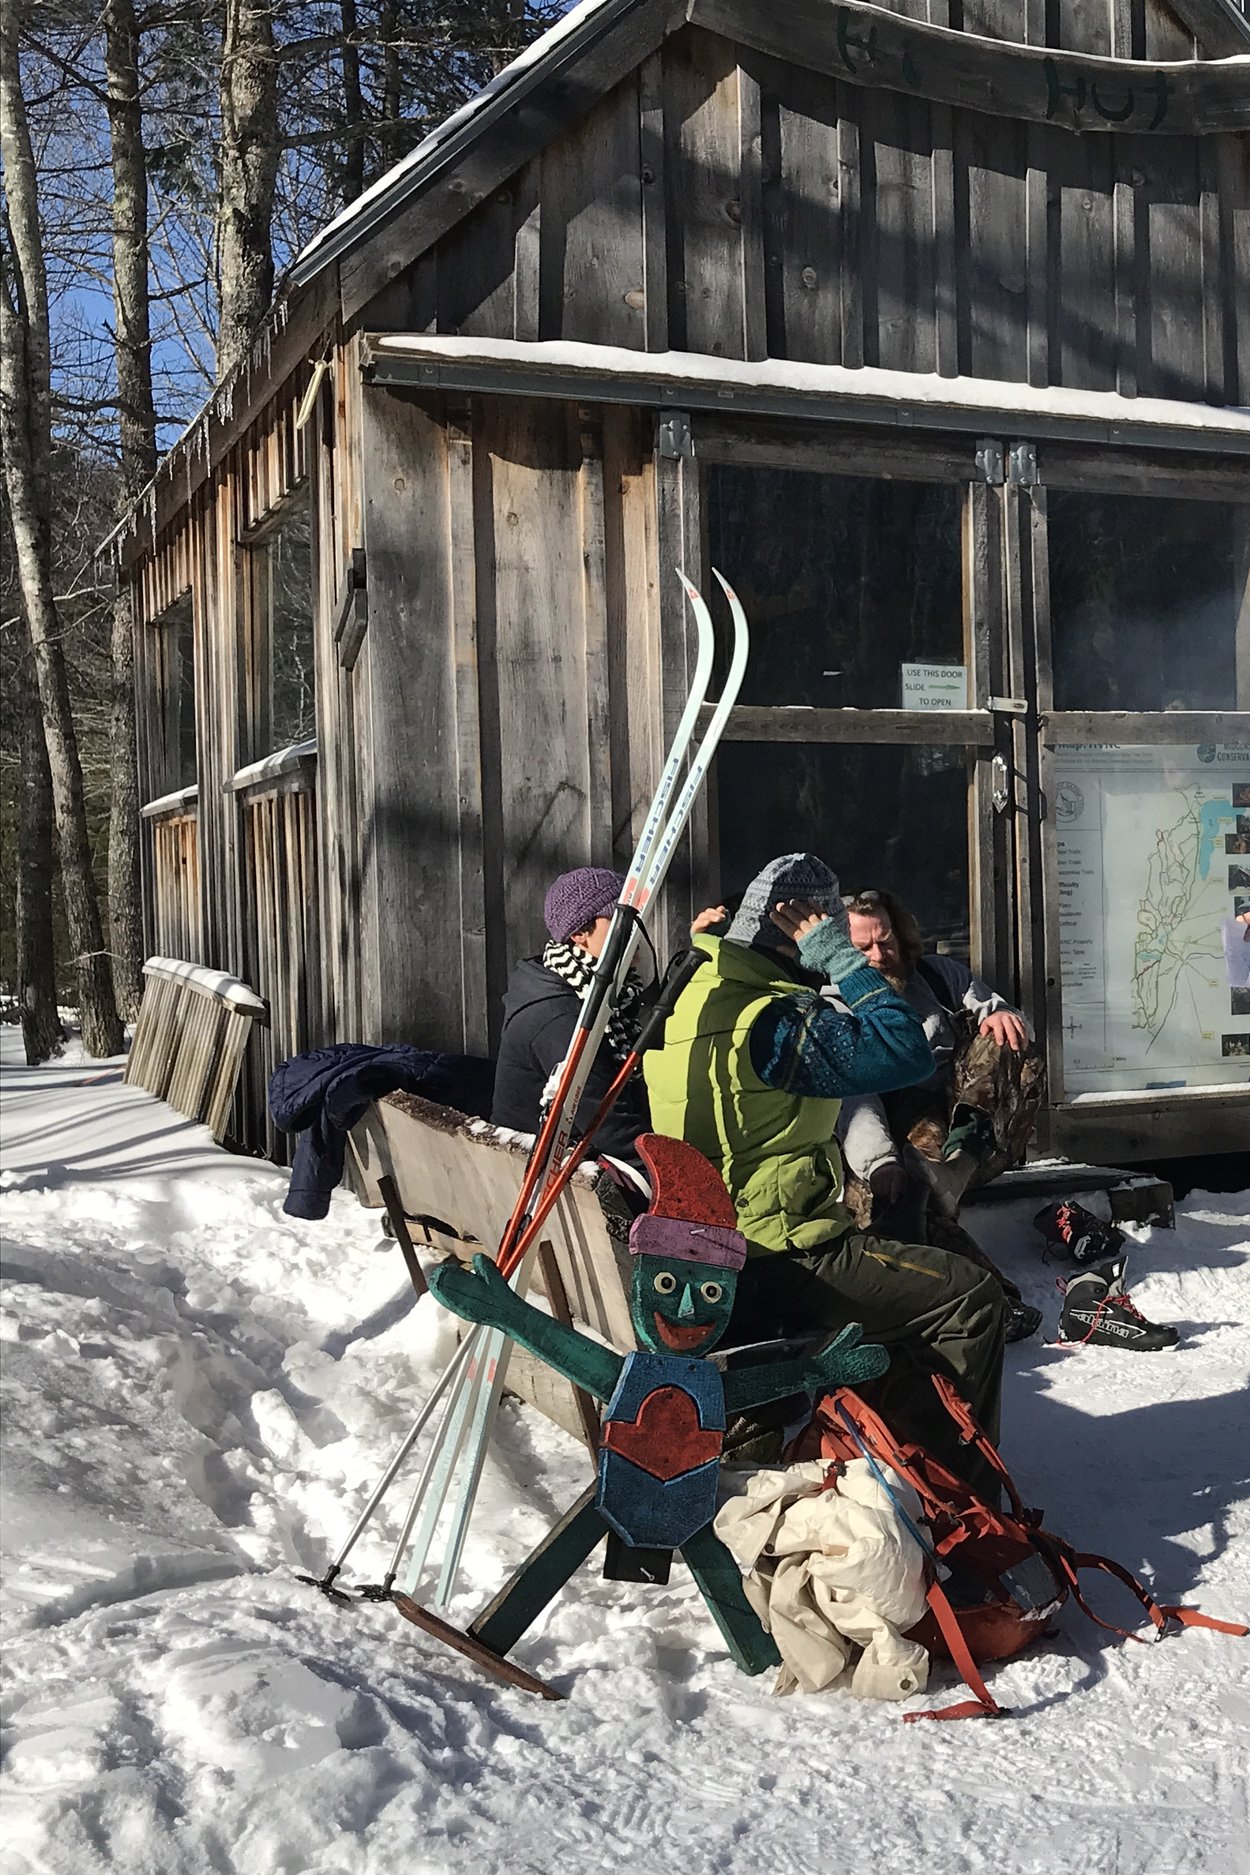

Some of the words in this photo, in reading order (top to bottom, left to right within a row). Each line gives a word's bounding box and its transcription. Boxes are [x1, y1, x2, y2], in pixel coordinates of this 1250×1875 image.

[906, 669, 921, 677] USE
[923, 669, 940, 678] THIS
[940, 670, 963, 678] DOOR
[905, 682, 926, 691] SLIDE
[919, 697, 930, 706] TO
[931, 698, 952, 706] OPEN
[636, 757, 680, 874] FISCHER
[649, 765, 703, 885] FISCHER
